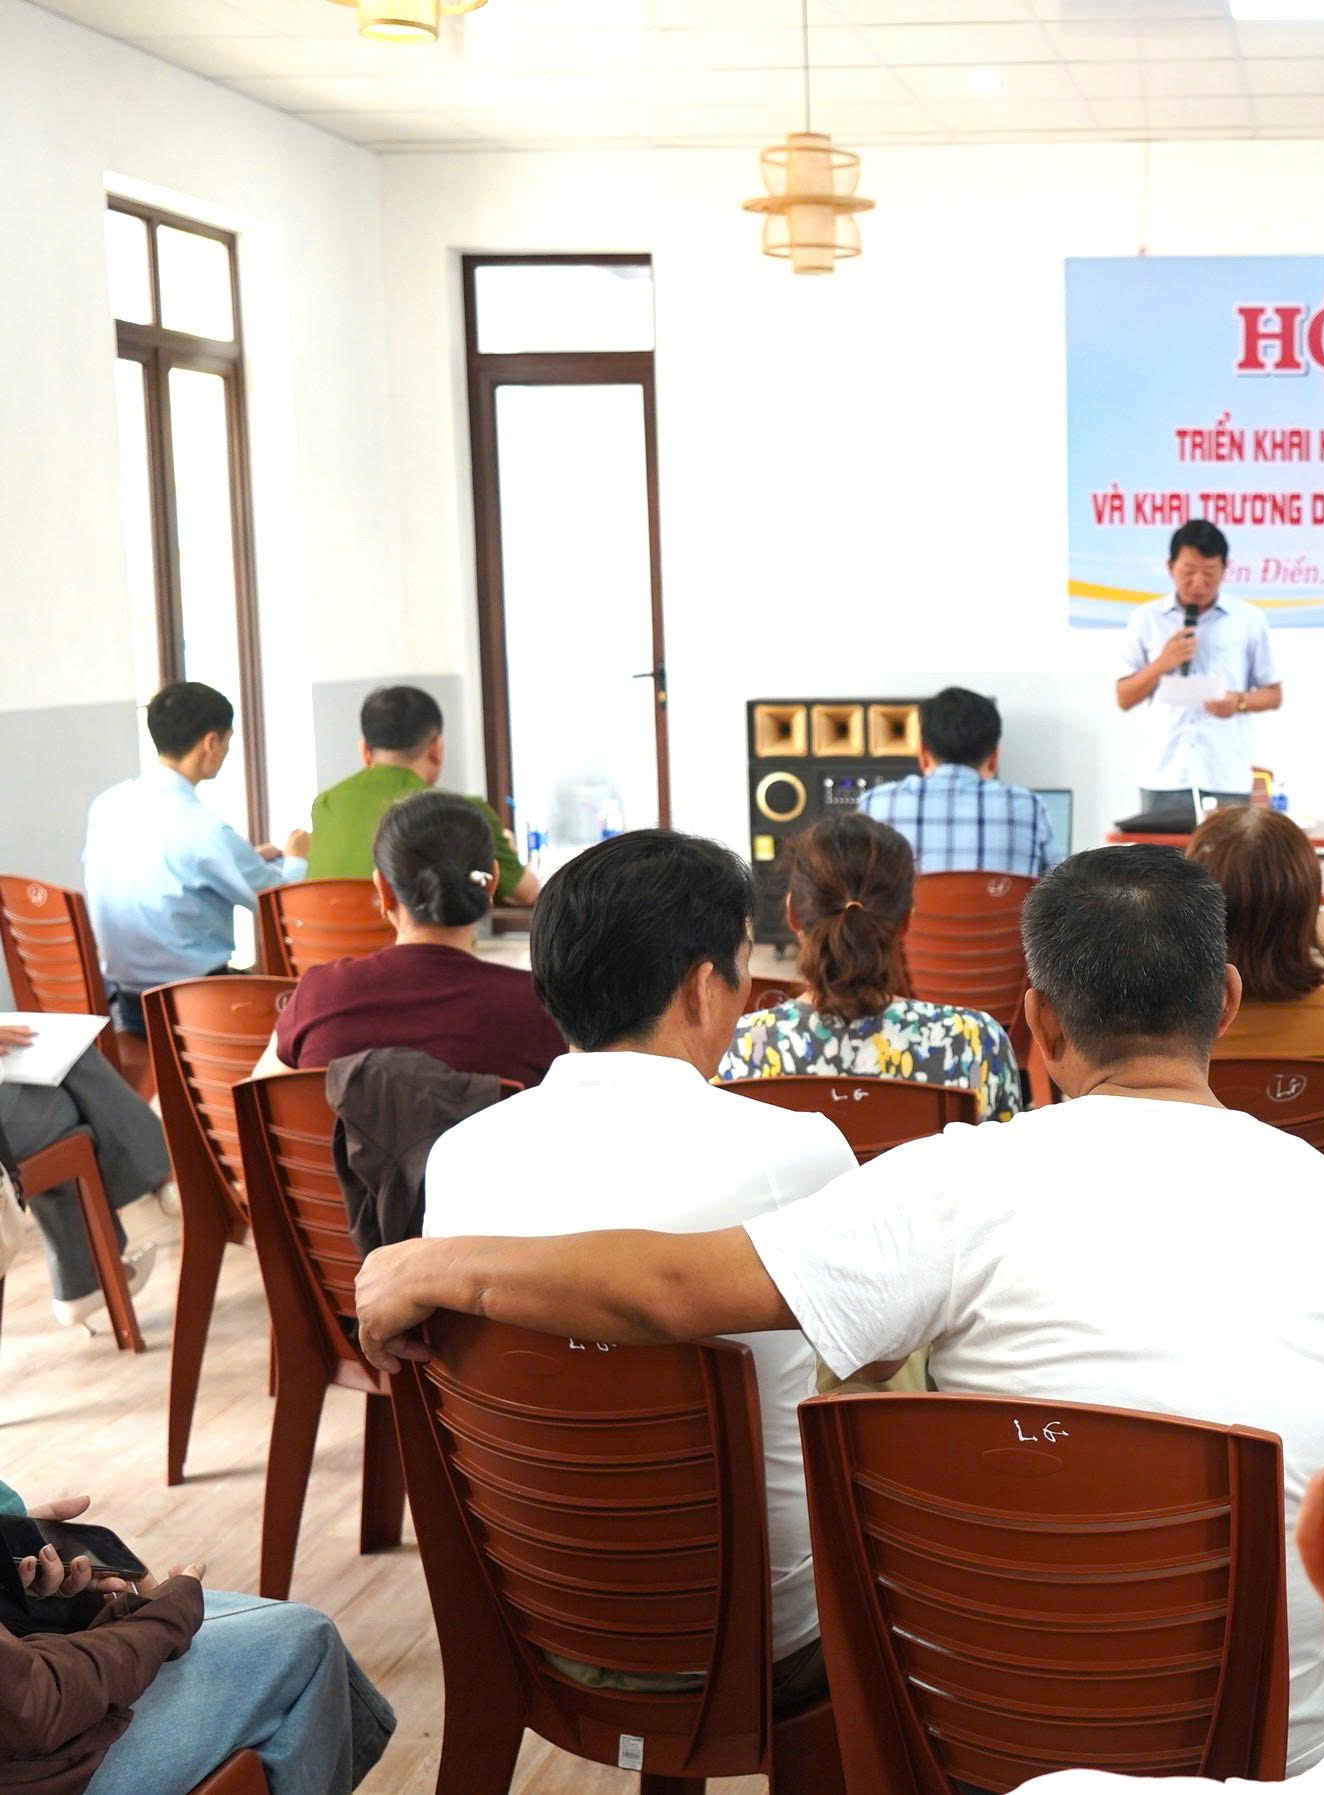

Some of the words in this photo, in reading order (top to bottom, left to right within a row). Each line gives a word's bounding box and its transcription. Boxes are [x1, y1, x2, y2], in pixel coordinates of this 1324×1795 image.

[1175, 411, 1245, 463] TRIỂN
[1253, 428, 1312, 463] KHAI
[1092, 483, 1125, 526] VÀ
[1133, 492, 1191, 526] KHAI
[1199, 492, 1303, 526] TRƯƠNG
